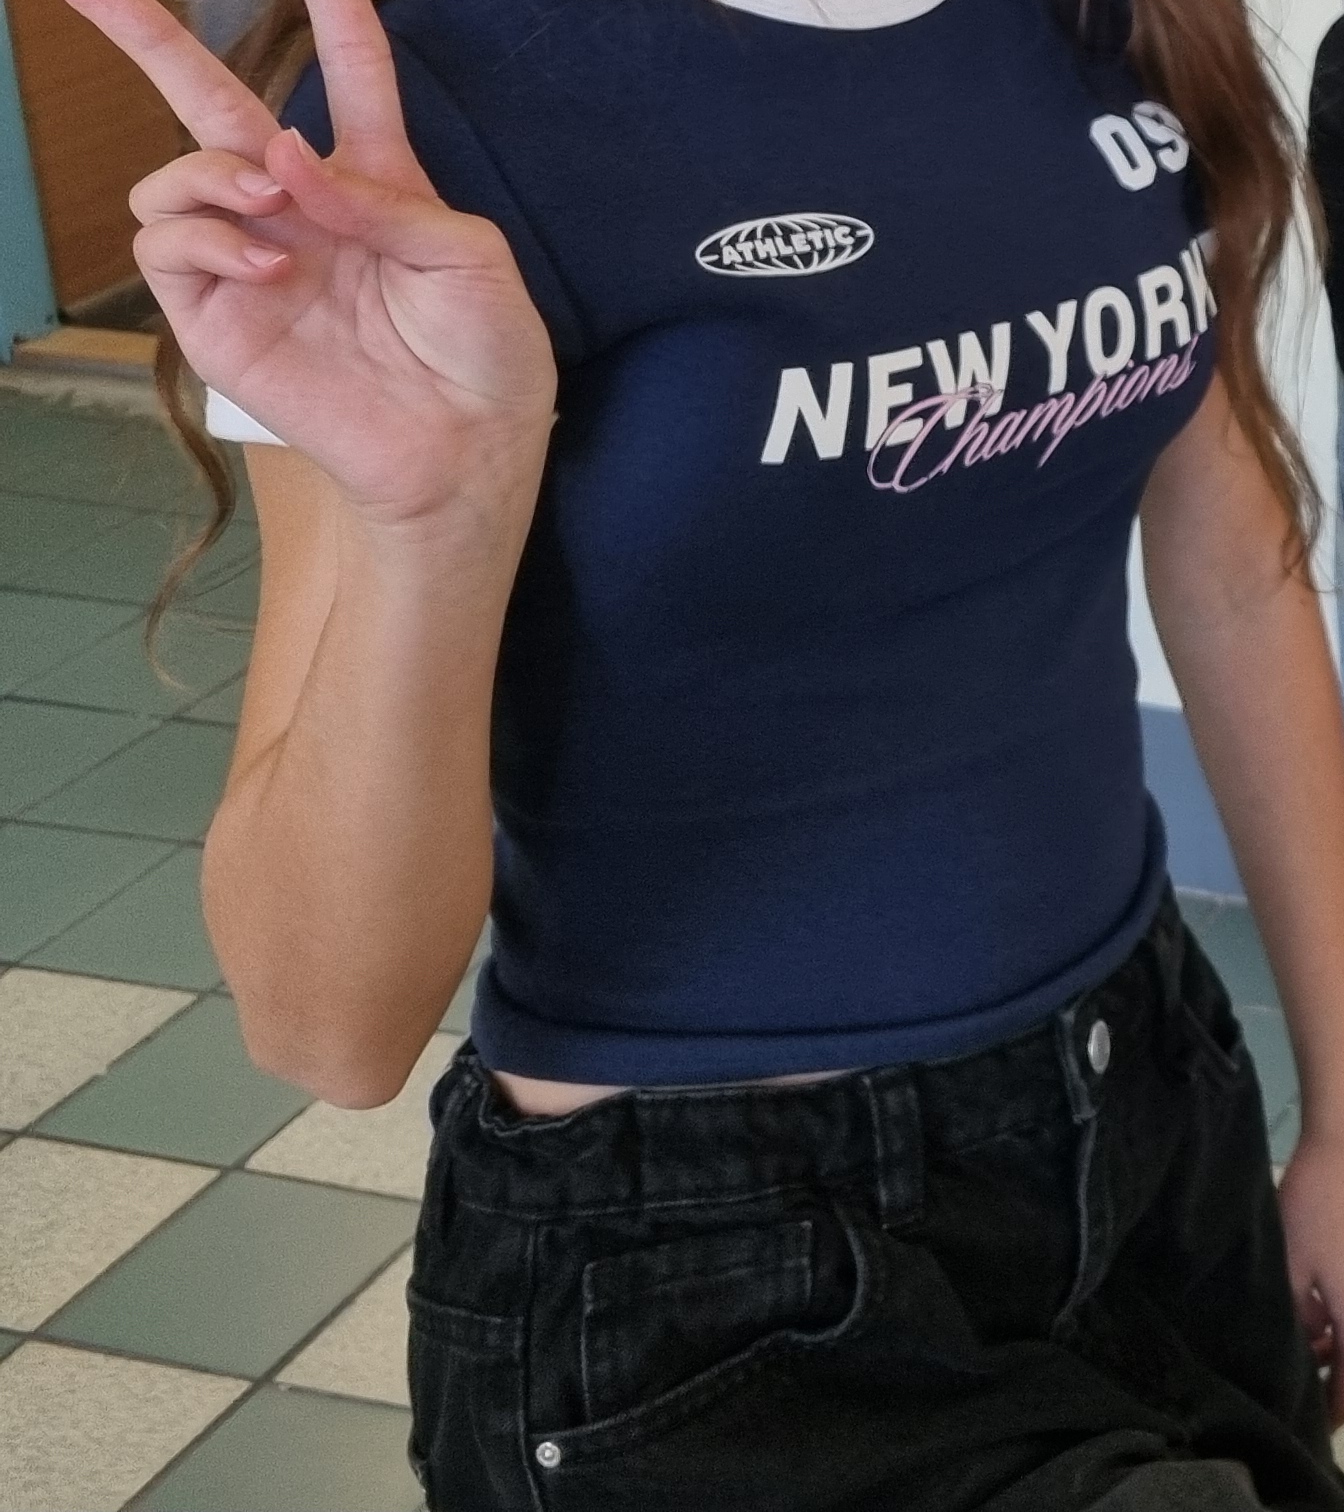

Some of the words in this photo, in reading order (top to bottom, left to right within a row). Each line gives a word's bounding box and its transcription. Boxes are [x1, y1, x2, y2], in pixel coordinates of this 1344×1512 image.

[721, 225, 855, 266] ATHLETIC
[761, 322, 1011, 464] NEW
[1025, 229, 1218, 393] YORK
[867, 334, 1197, 493] Champions
